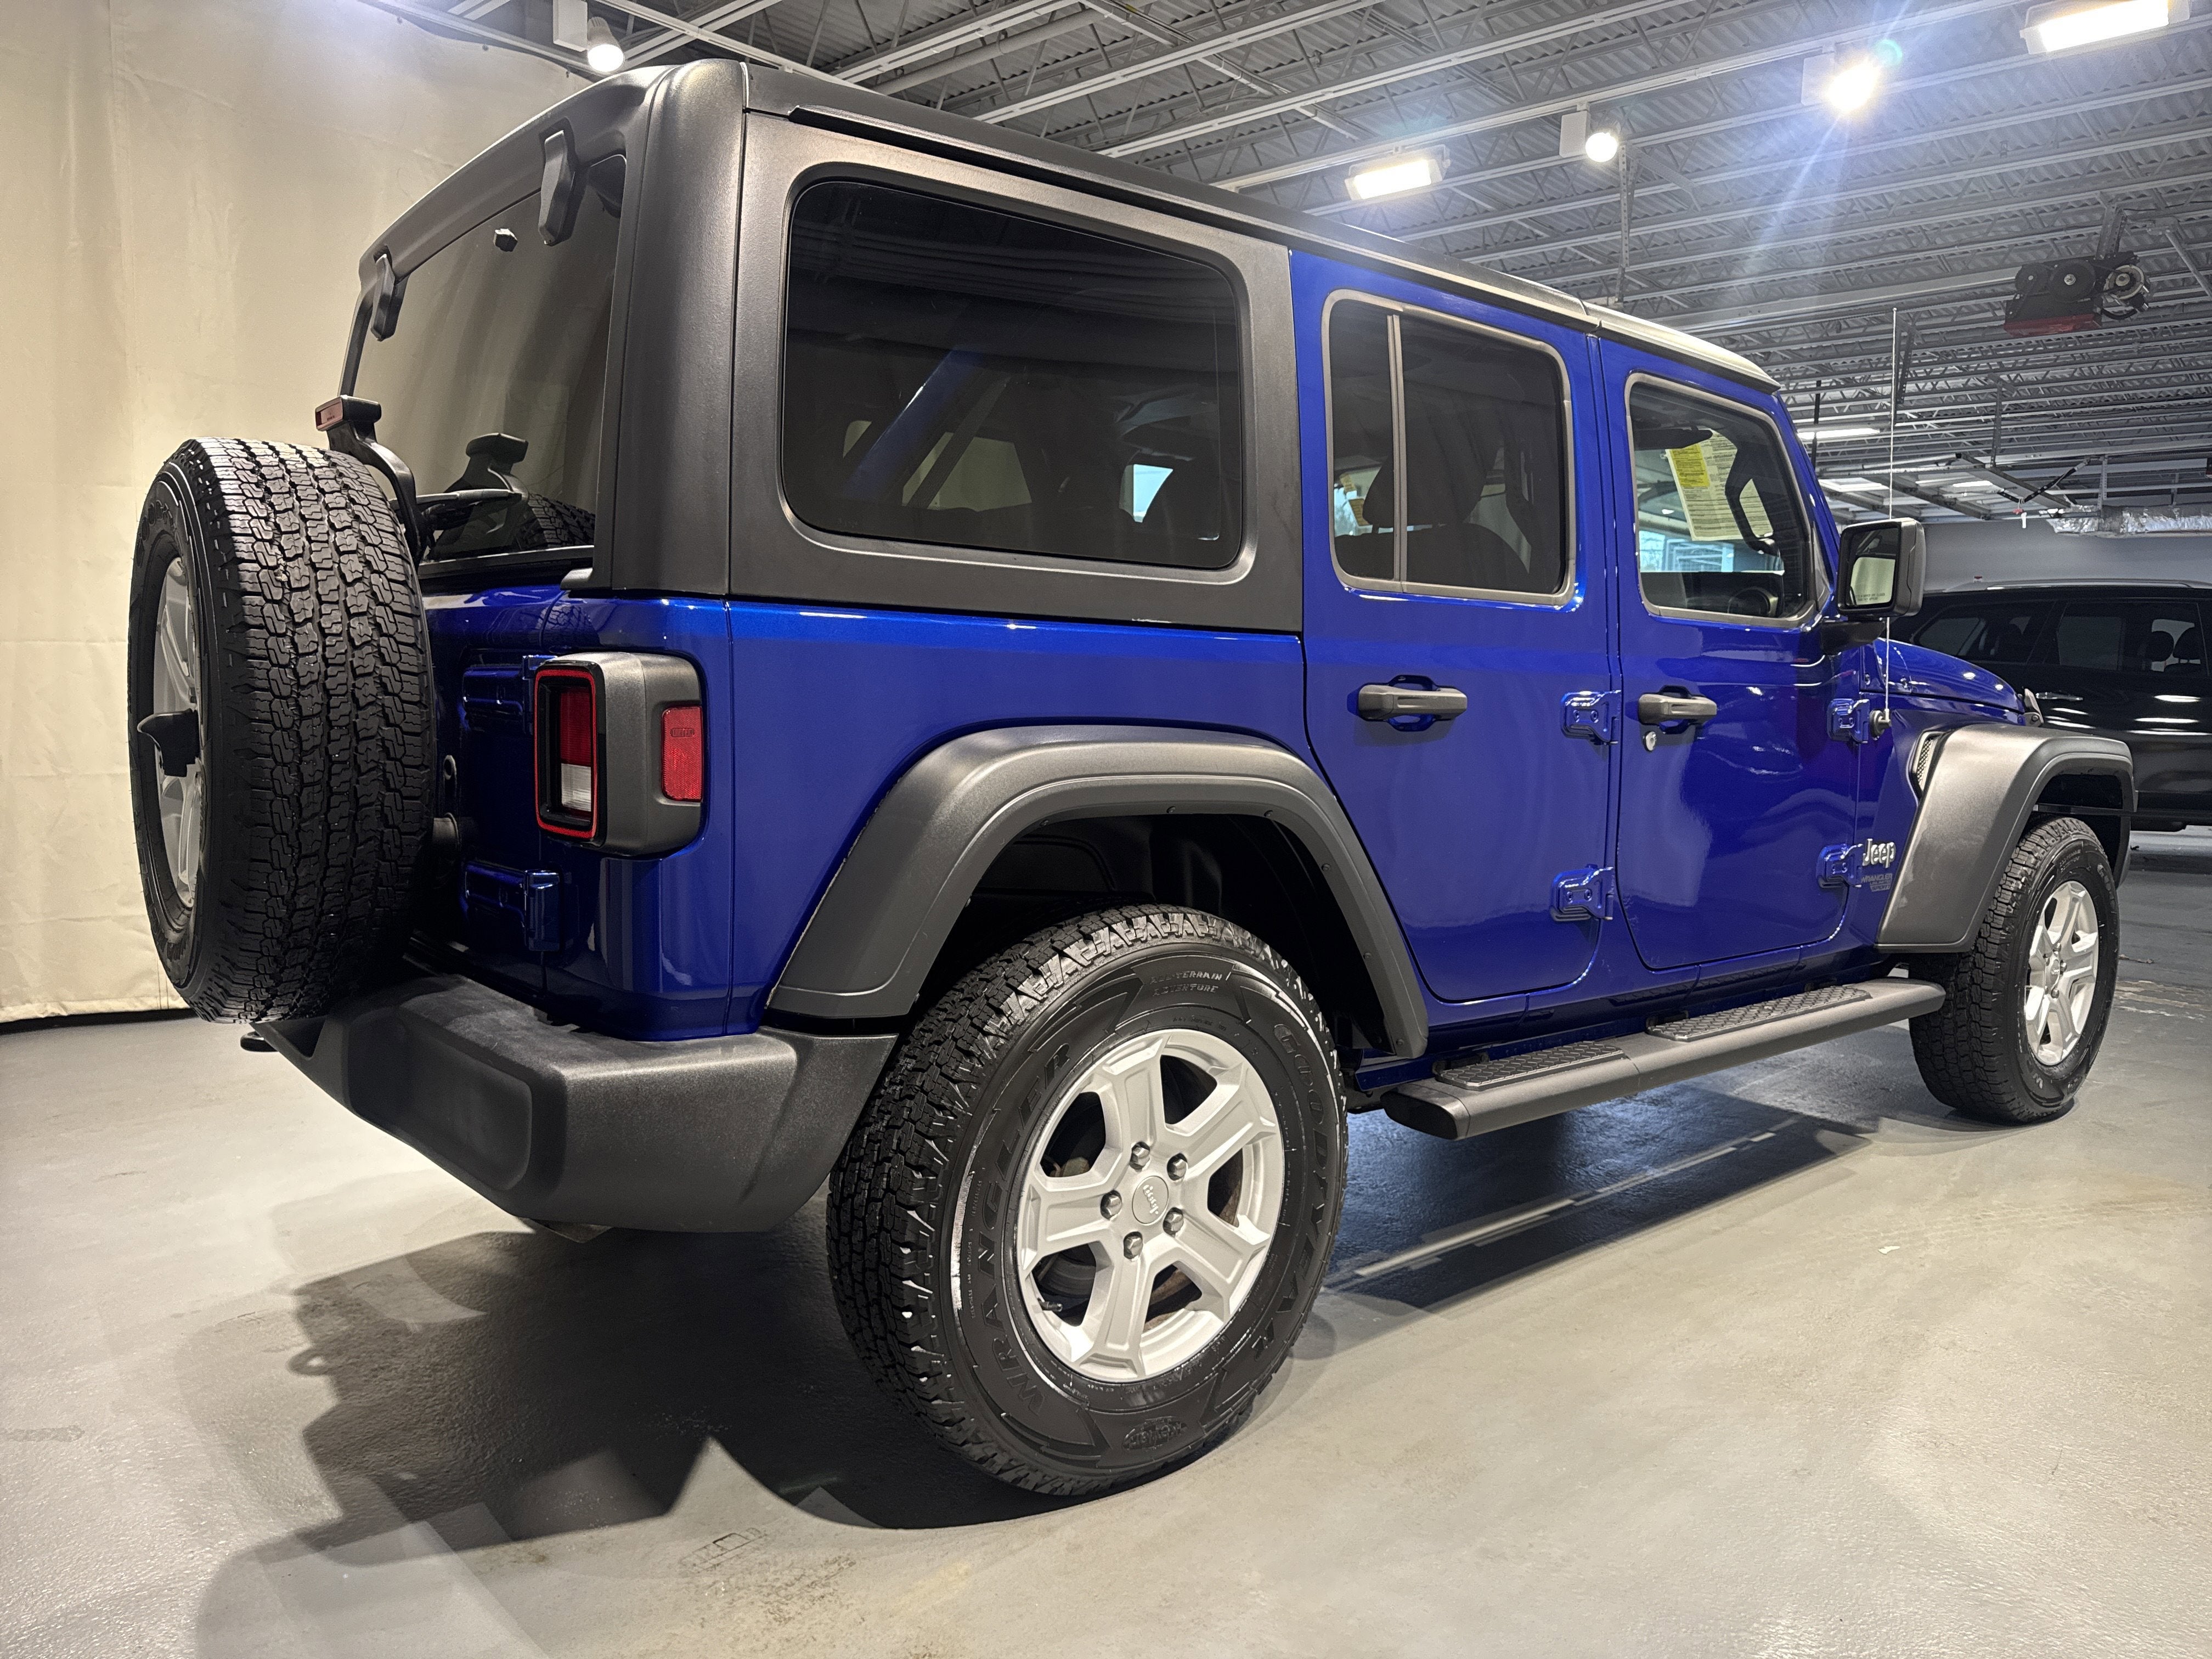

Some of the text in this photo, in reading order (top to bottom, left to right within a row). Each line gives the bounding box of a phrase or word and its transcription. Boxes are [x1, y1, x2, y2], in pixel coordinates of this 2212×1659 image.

[1861, 873, 1893, 883] WRANGLER
[1862, 838, 1897, 868] Jeep
[978, 1042, 1070, 1416] WRANGLER
[1251, 1023, 1328, 1362] GOODYEAR
